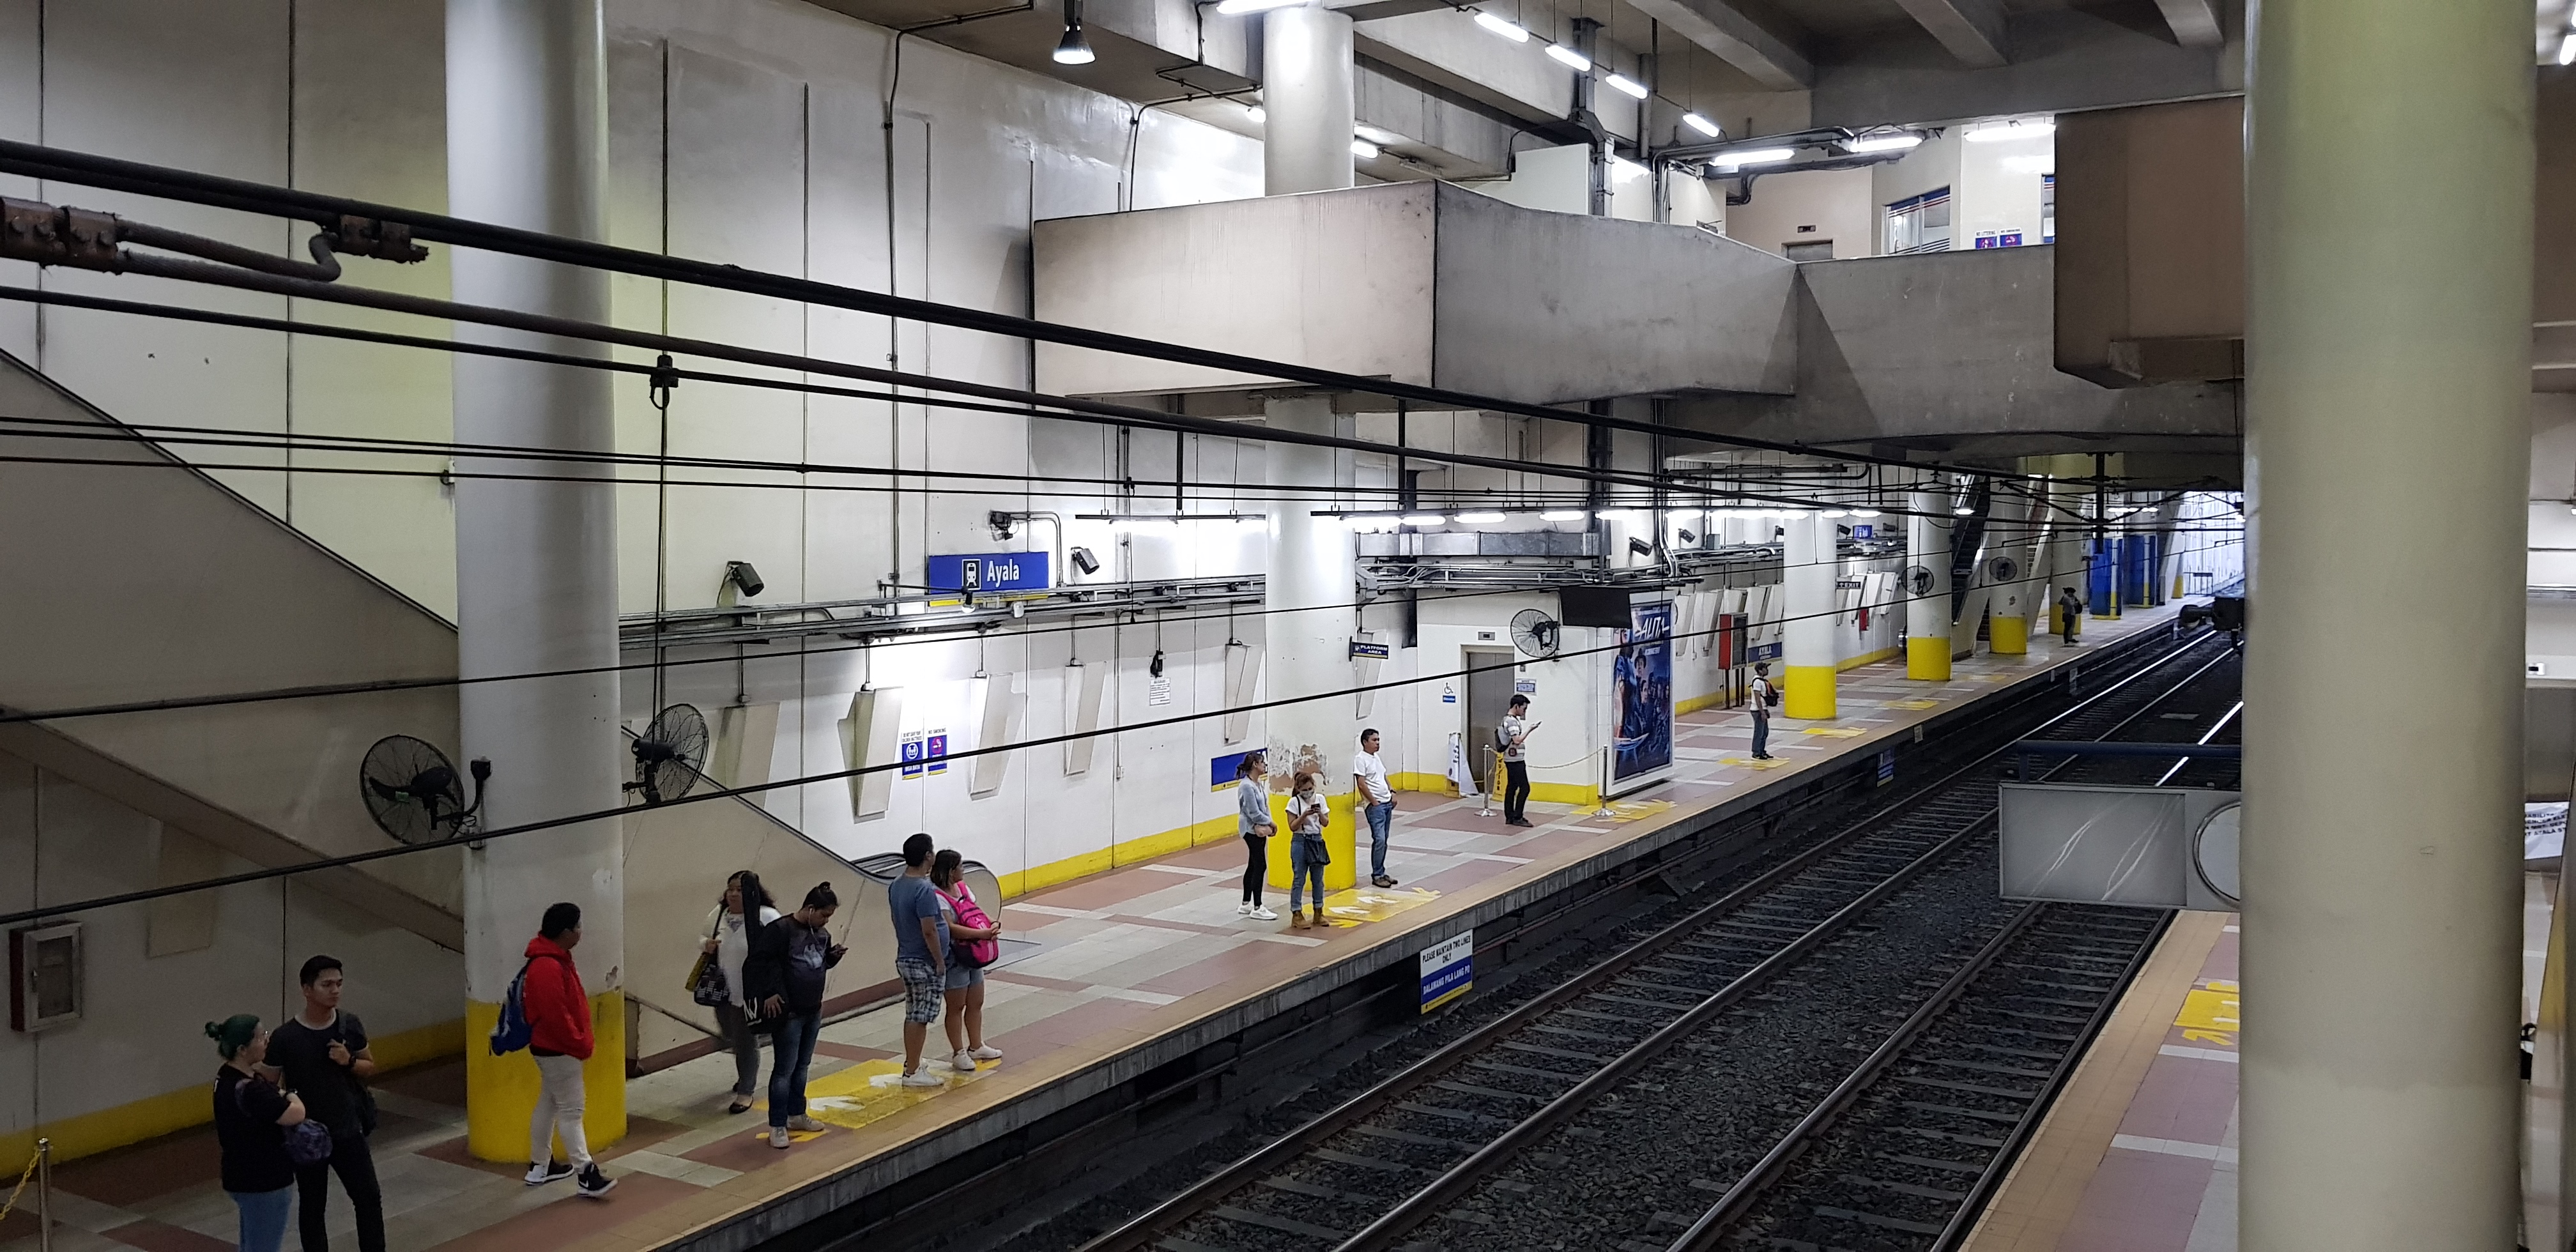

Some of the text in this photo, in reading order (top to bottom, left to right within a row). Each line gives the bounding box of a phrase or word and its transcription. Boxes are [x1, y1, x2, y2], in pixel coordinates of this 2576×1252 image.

[987, 559, 1020, 588] Ayala
[1758, 645, 1772, 656] AYALA
[1422, 950, 1436, 964] PLEASE
[1436, 943, 1452, 957] MAINTAIN
[1460, 935, 1471, 946] LINES
[1443, 952, 1452, 964] ONLY
[1423, 965, 1470, 995] DALAWANG PILA LANG PO
